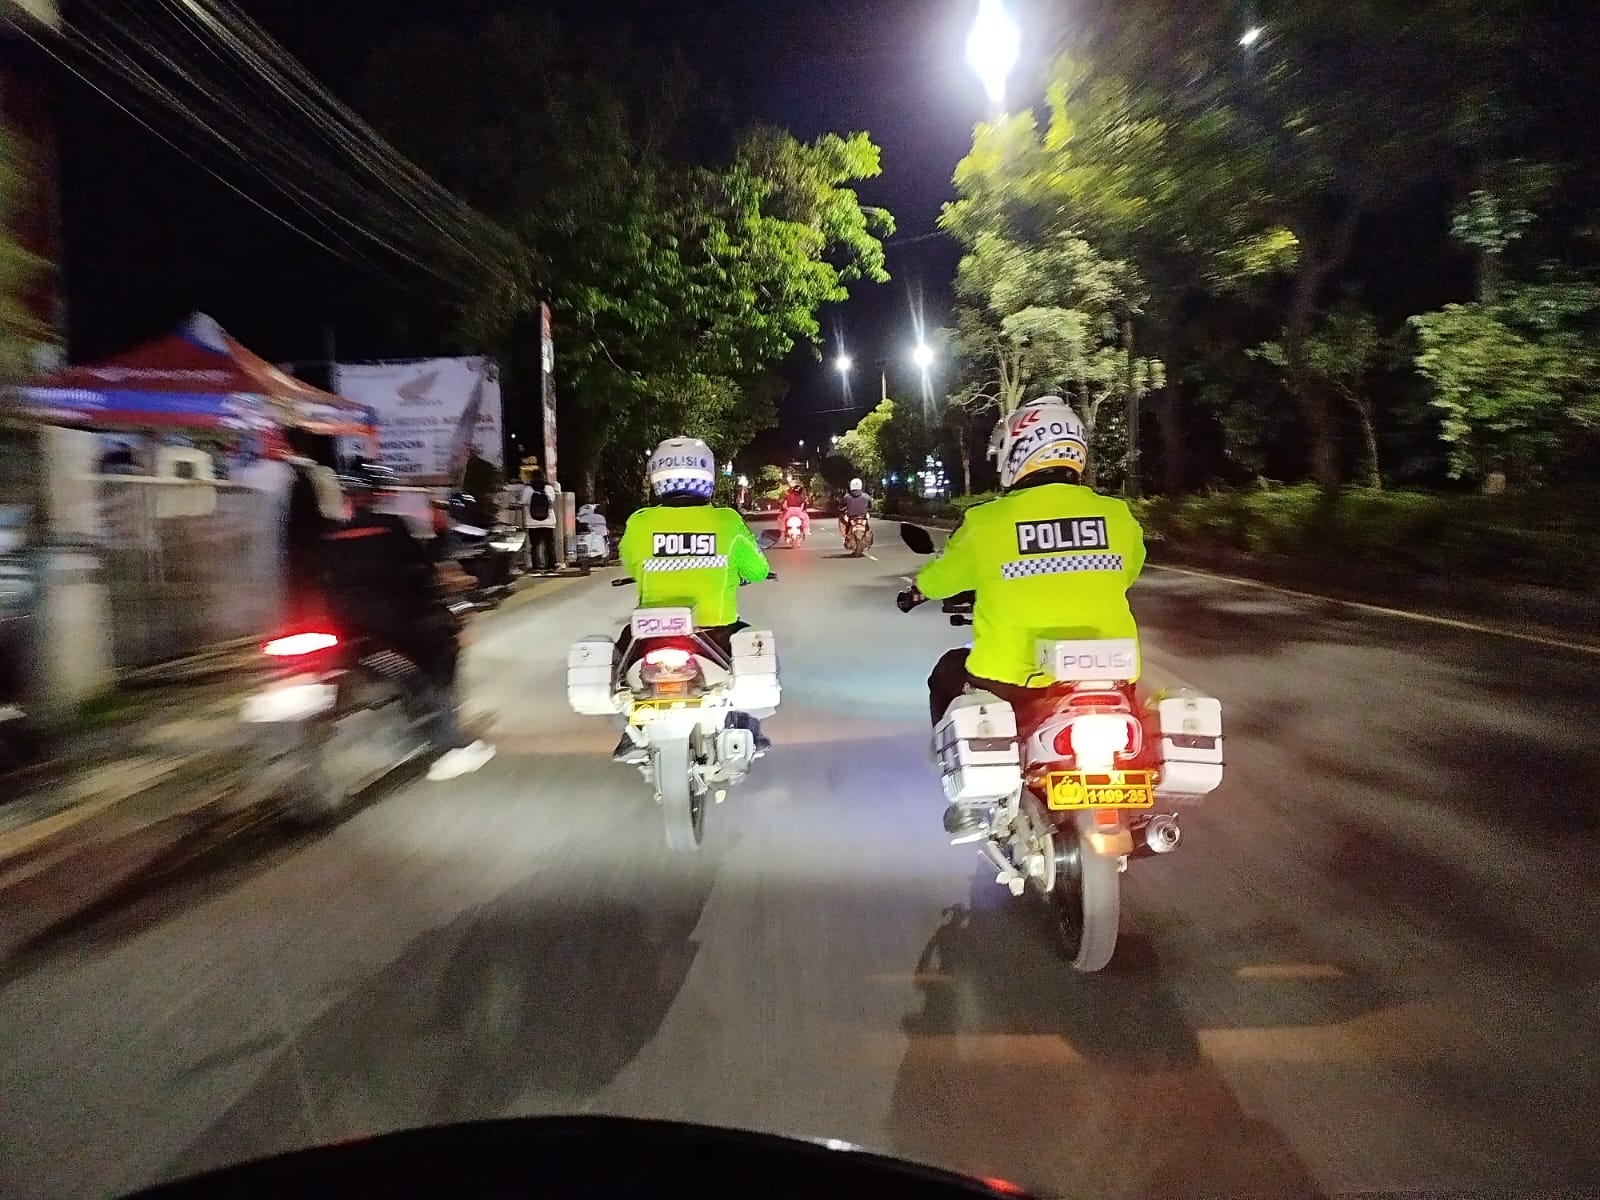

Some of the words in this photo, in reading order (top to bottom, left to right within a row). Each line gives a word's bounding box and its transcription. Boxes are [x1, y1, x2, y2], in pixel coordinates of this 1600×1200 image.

[658, 455, 698, 468] POLISI
[1018, 520, 1107, 550] POLISI
[653, 533, 715, 555] POLISI
[637, 617, 687, 631] POLISI
[1063, 653, 1133, 669] POLISI
